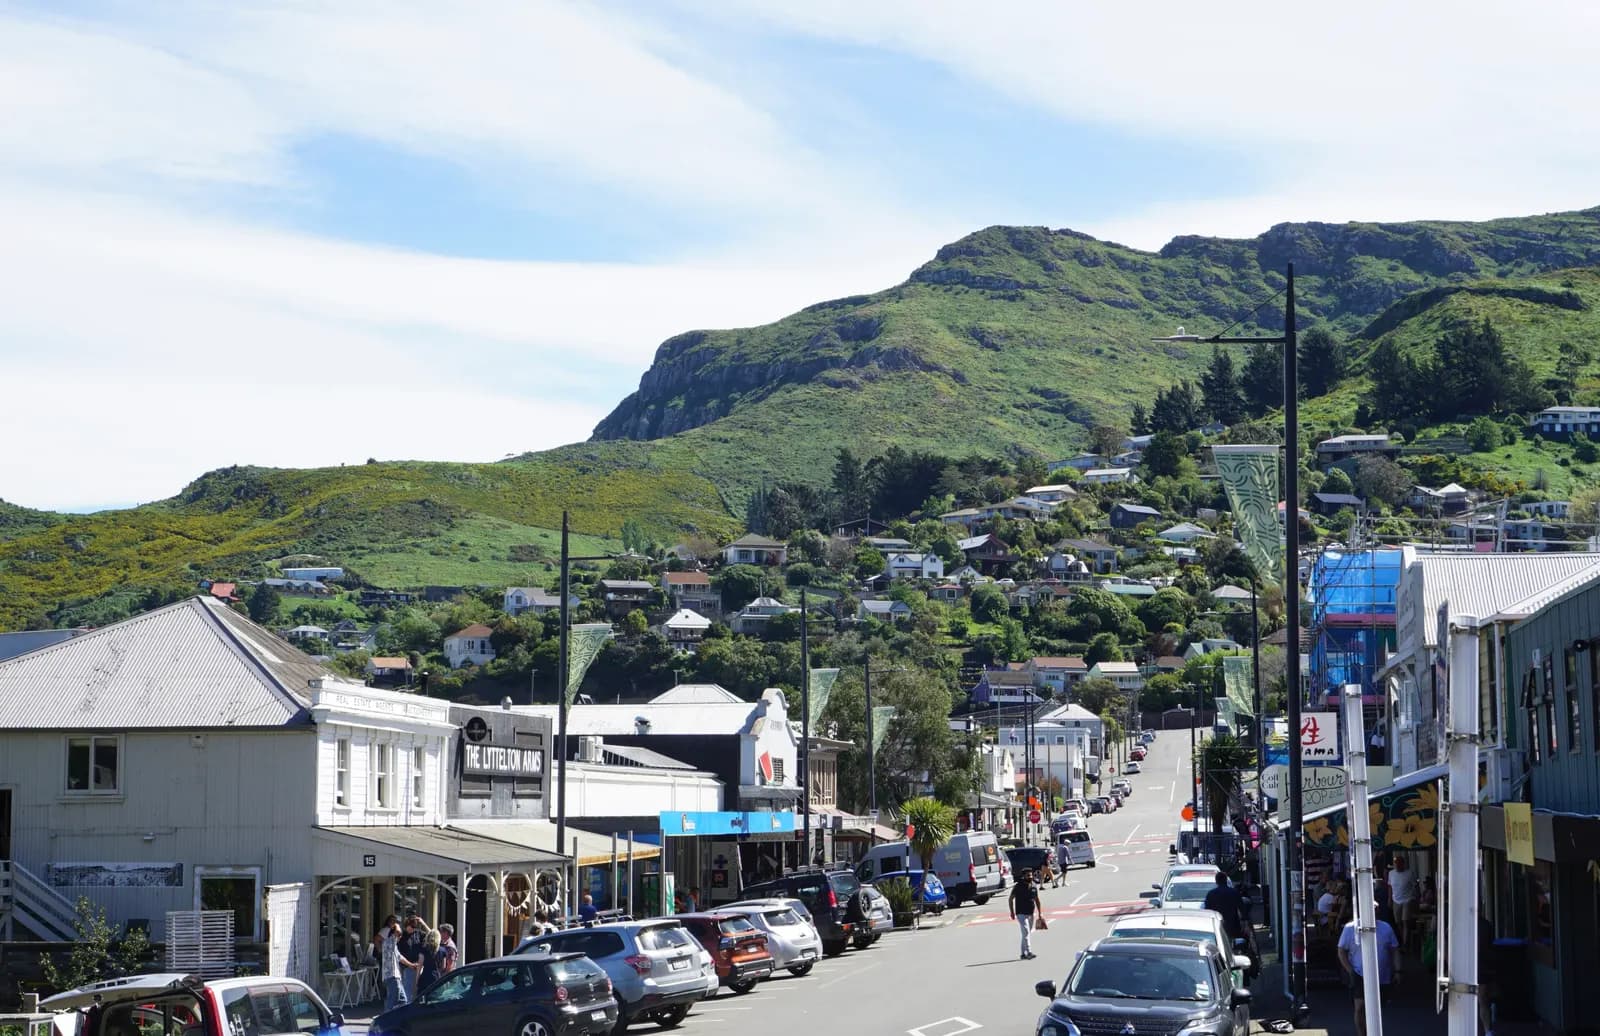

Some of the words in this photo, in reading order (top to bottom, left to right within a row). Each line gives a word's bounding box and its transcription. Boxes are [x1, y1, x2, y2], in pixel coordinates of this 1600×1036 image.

[465, 744, 480, 769] THE
[482, 746, 520, 772] LYTTELTON
[522, 750, 541, 773] ARMS
[365, 856, 374, 865] 15
